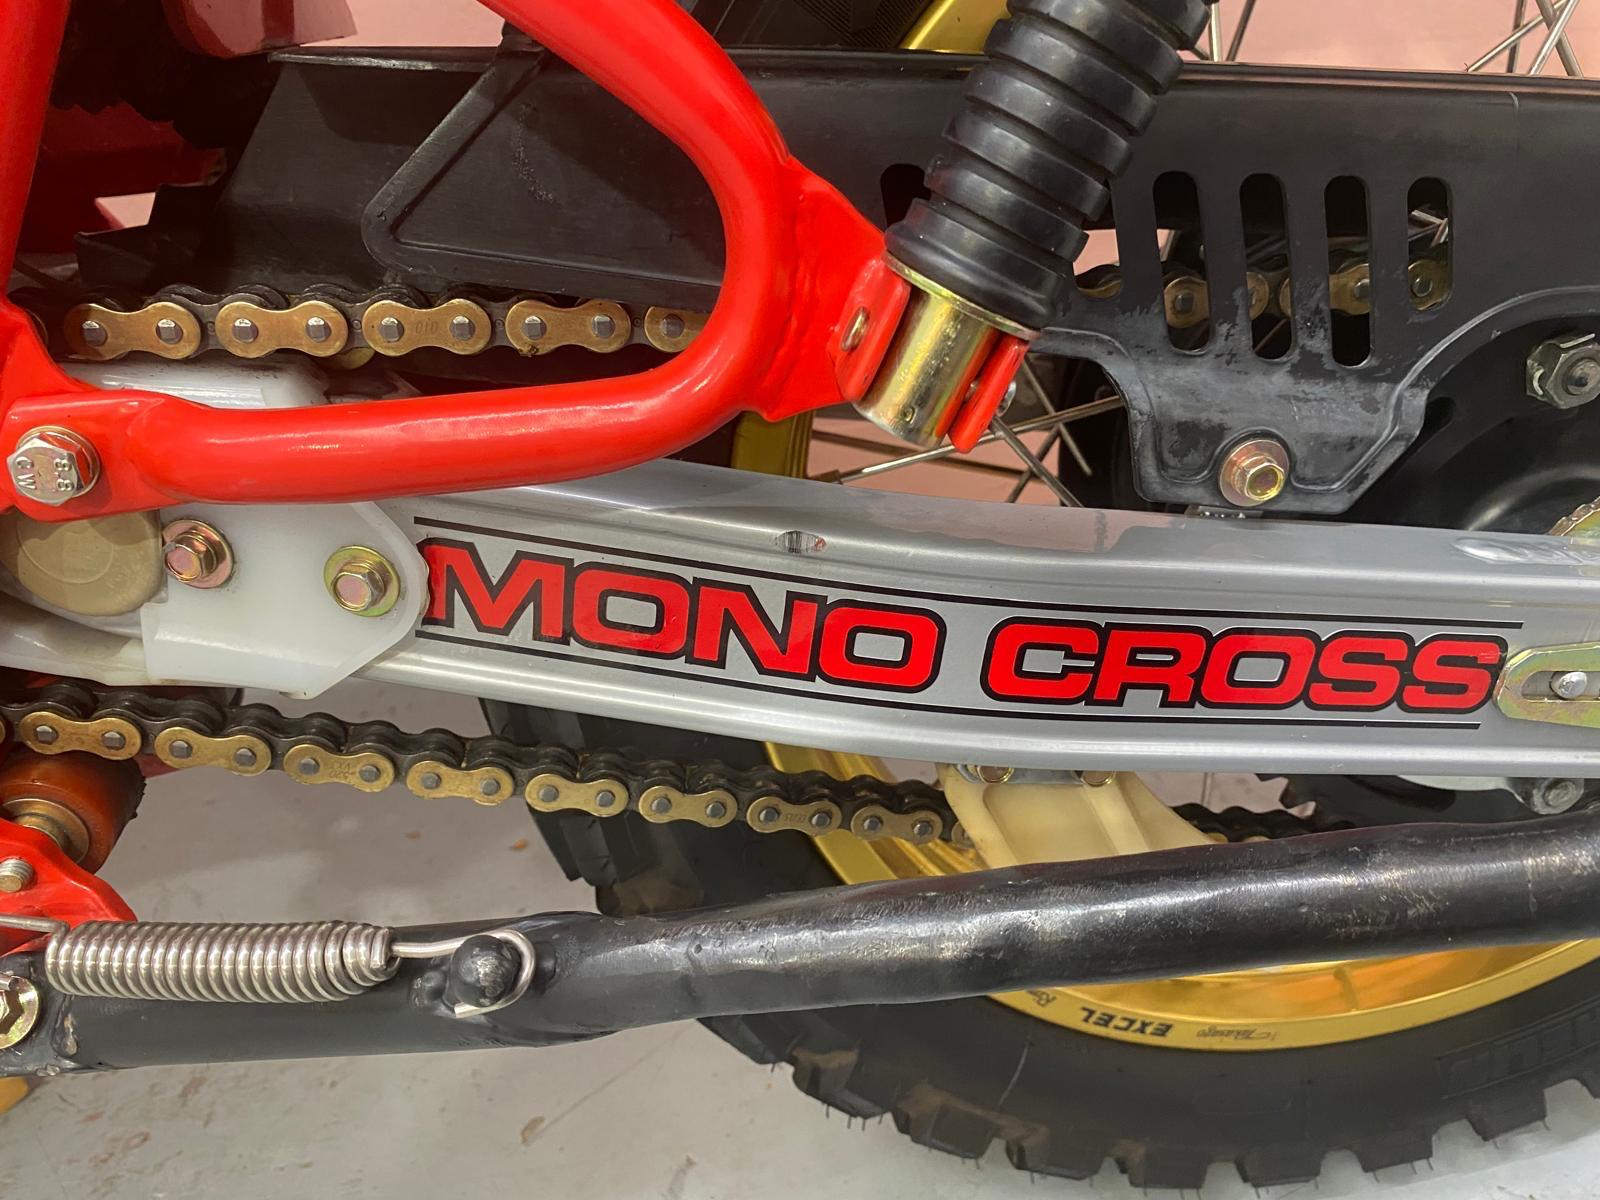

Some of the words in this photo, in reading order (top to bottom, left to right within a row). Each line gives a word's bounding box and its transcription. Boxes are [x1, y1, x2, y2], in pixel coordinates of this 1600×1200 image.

[53, 457, 76, 492] 8.8
[416, 537, 948, 694] MONO
[979, 615, 1508, 715] CROSS
[1079, 1006, 1175, 1038] EXCEL
